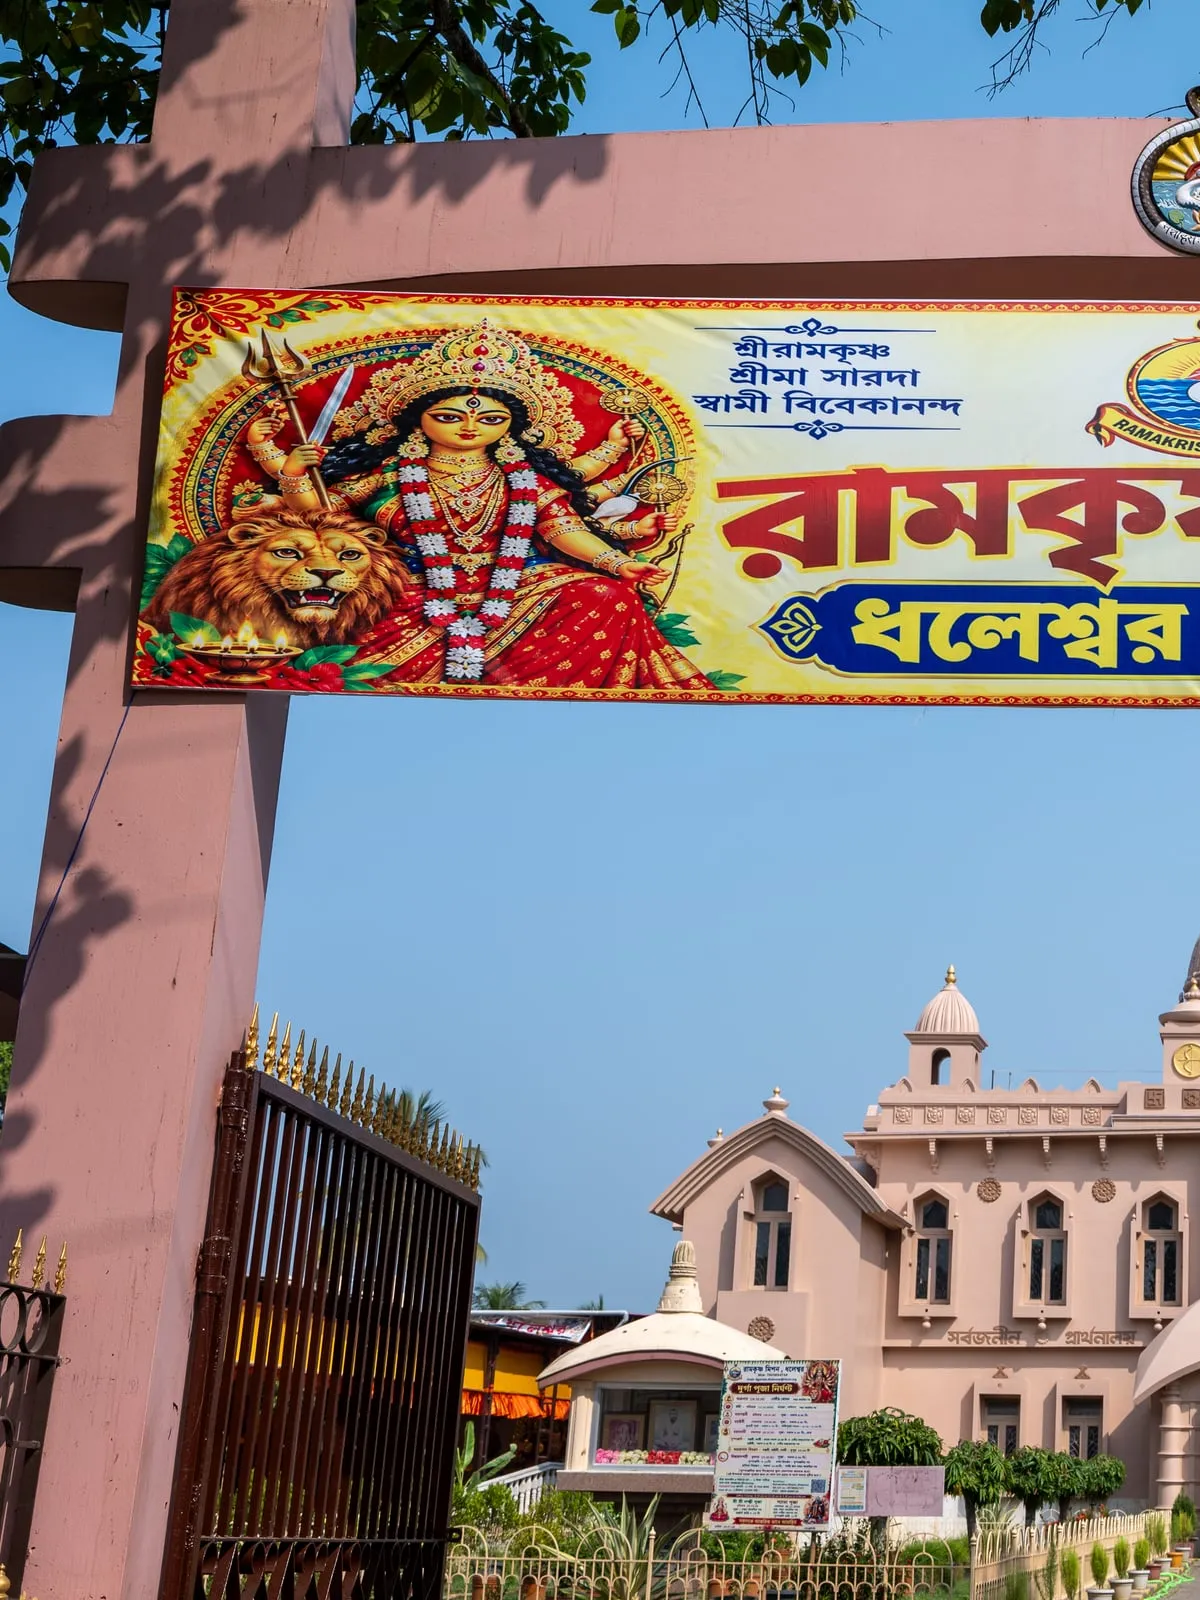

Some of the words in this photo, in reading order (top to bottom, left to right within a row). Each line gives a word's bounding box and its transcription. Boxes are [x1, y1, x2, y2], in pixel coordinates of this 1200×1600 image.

[732, 335, 890, 364] শ্রীরামকৃষ্ণ
[728, 361, 809, 387] শ্রীমা
[820, 367, 921, 388] সারদা
[692, 389, 771, 414] স্বামী
[782, 390, 964, 416] বিবেকানন্দ
[851, 597, 1189, 669] ধলেশ্বর
